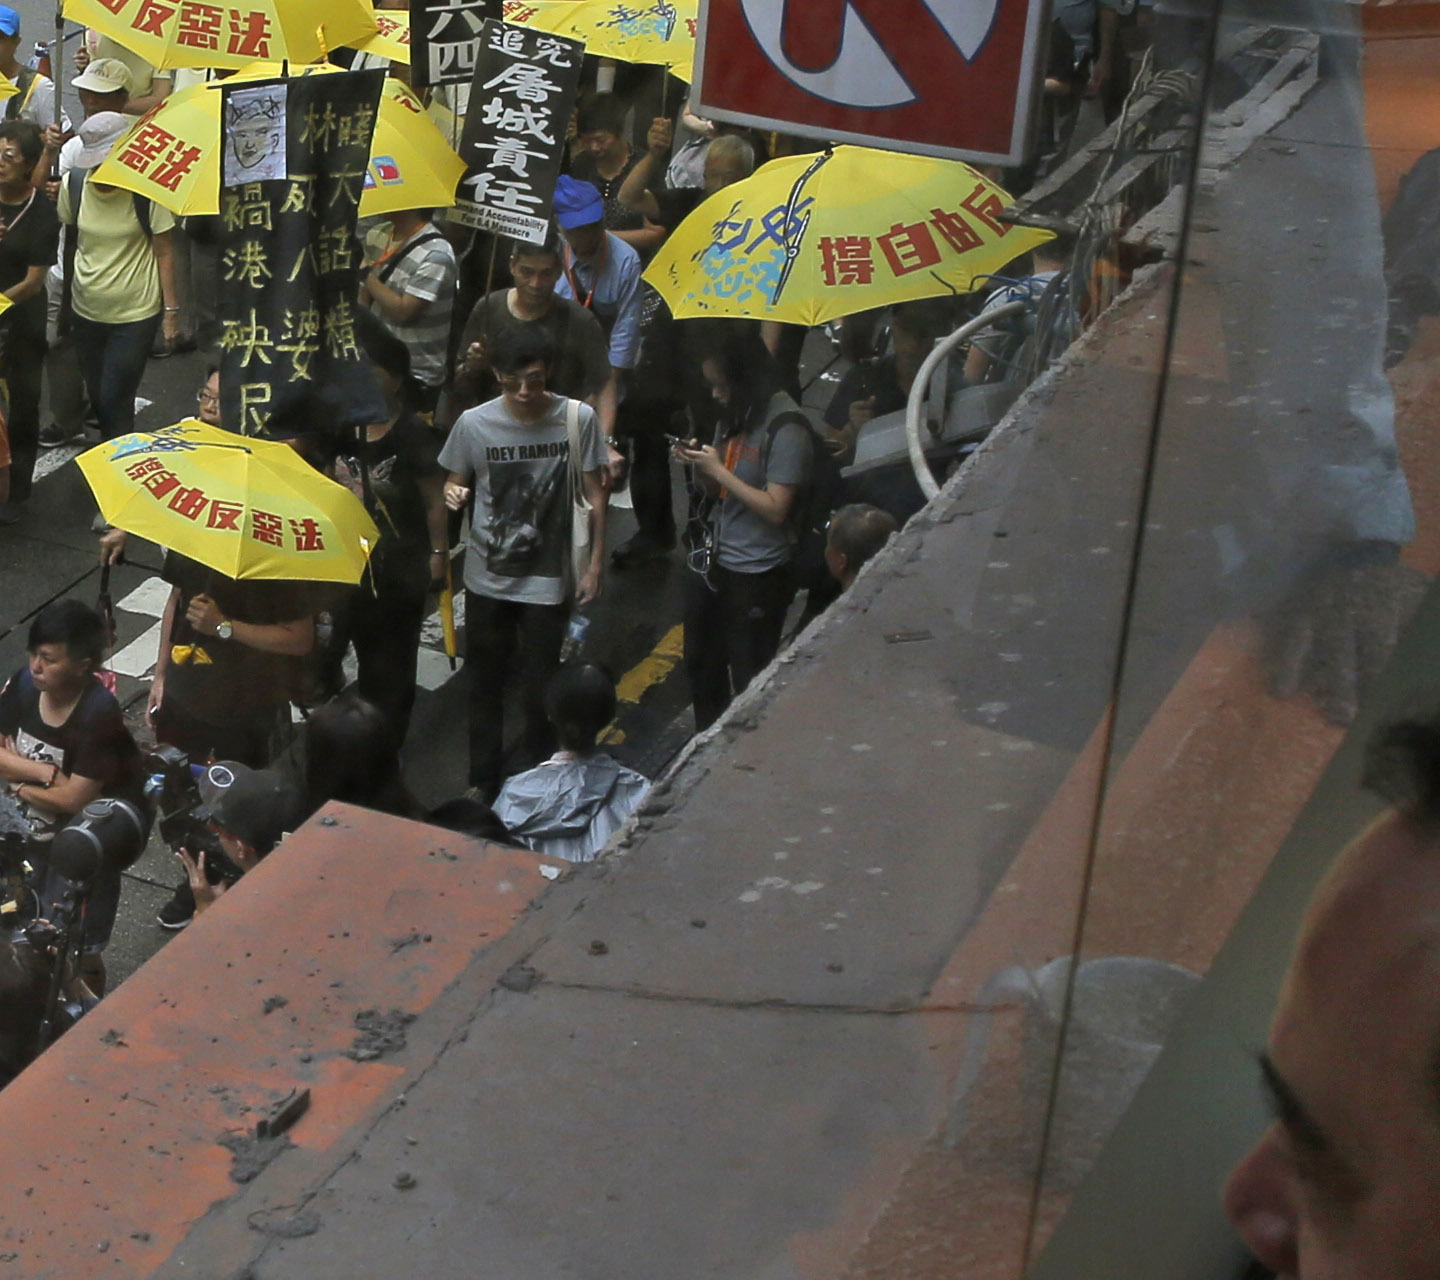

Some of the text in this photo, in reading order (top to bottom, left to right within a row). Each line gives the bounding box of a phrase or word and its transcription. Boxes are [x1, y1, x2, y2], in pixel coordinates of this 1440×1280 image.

[489, 25, 572, 68] 追究
[464, 63, 563, 213] 屠城責任
[485, 208, 545, 231] Accountability
[491, 221, 530, 239] Massacre
[486, 446, 515, 461] JOEY
[127, 455, 326, 553] 撐自由反惡法
